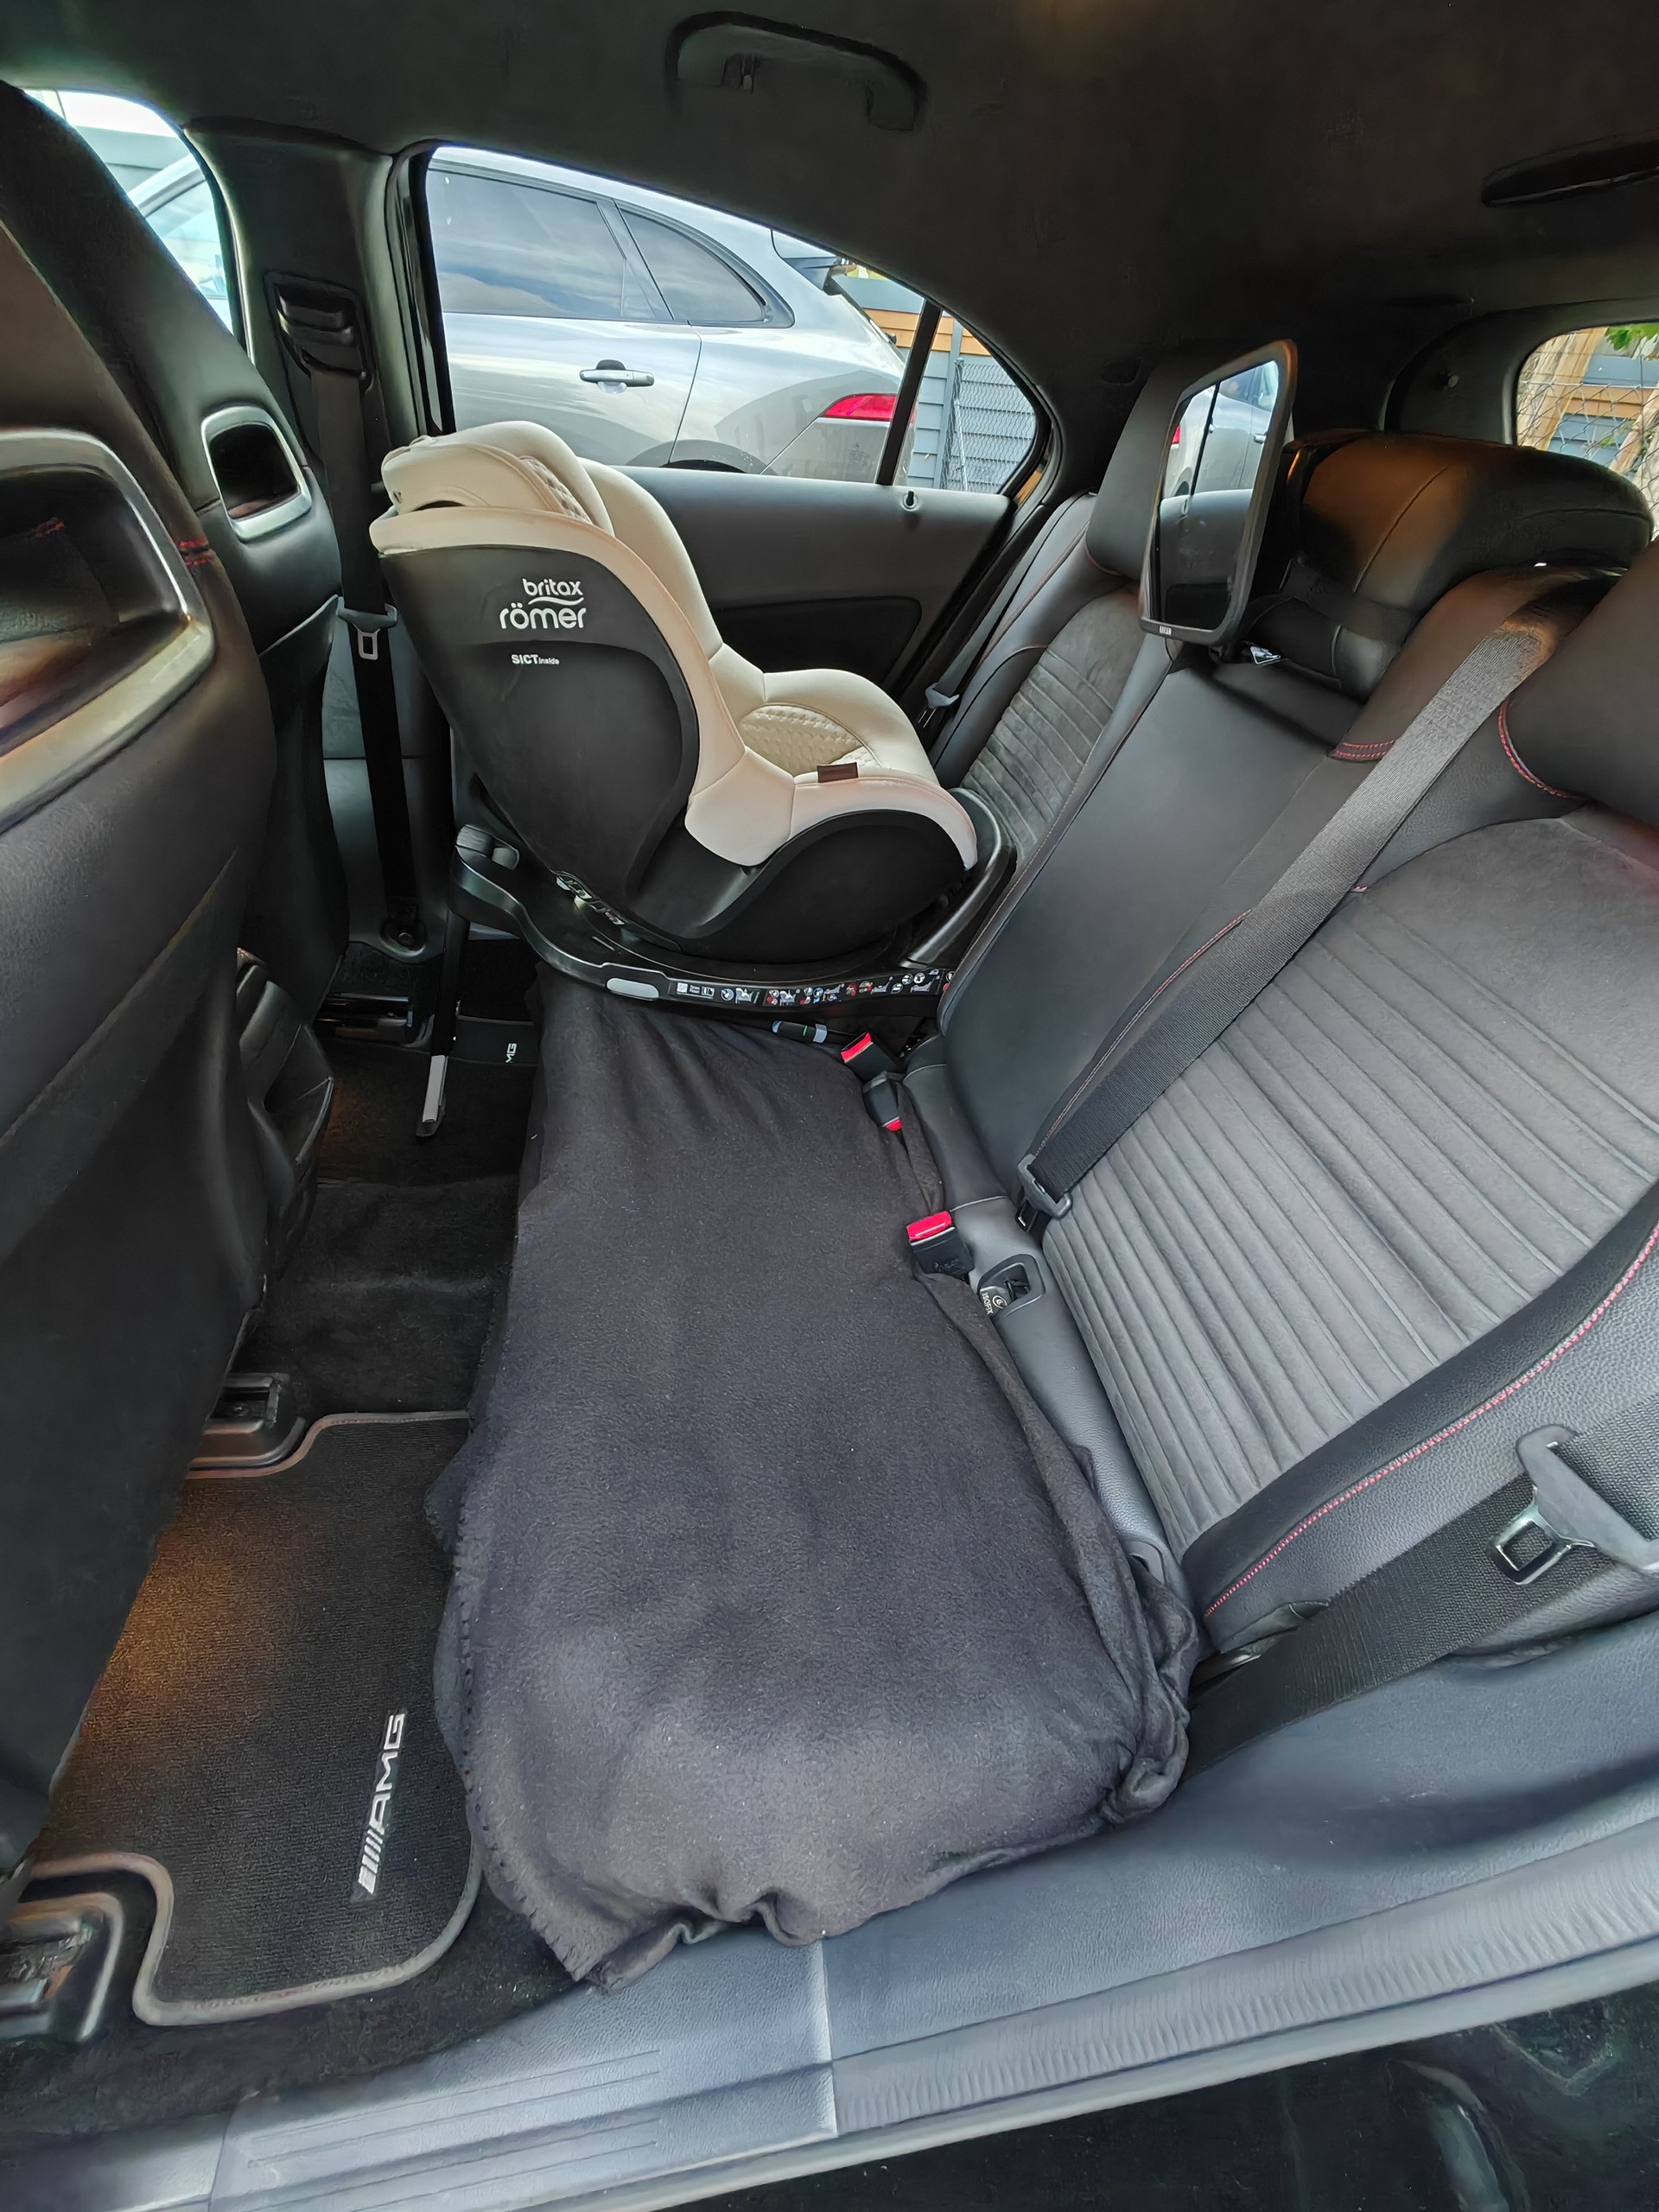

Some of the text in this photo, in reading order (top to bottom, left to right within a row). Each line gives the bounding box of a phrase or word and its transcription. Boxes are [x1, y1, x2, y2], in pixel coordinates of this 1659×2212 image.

[523, 578, 583, 595] britax
[499, 602, 587, 629] römer
[505, 1043, 518, 1064] MG
[982, 1293, 994, 1314] ISOFIX
